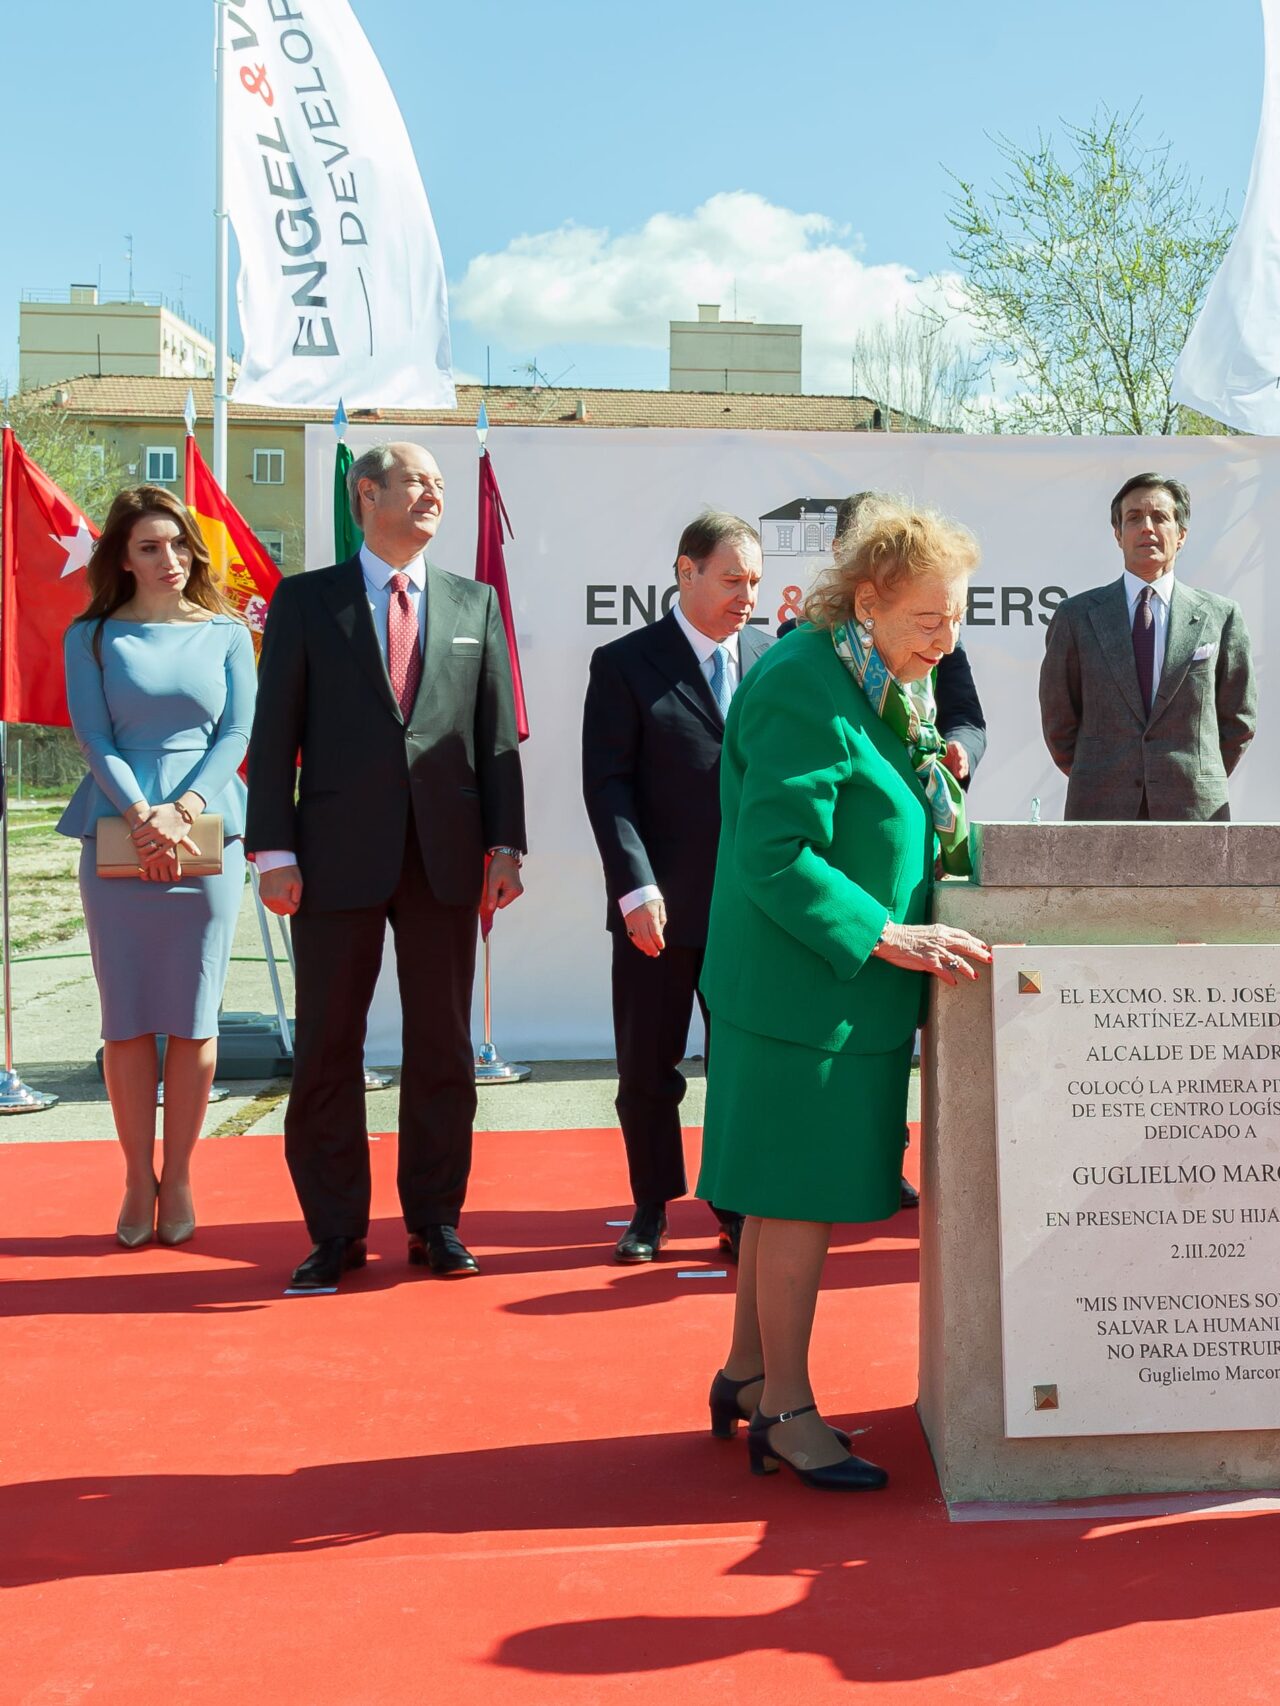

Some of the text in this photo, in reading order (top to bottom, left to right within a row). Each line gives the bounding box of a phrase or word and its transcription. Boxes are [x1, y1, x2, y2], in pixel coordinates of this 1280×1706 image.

[227, 0, 340, 356] ENGEL & V
[1059, 988, 1085, 1005] EL
[1089, 987, 1167, 1004] EXCMO.
[1172, 987, 1202, 1004] SR.
[1206, 987, 1226, 1003] D.
[1231, 983, 1277, 1003] JOSÉ
[1085, 1044, 1184, 1062] ALCALDE
[1189, 1044, 1217, 1061] DE
[1067, 1075, 1144, 1096] COLOCÓ
[1148, 1079, 1174, 1094] LA
[1177, 1079, 1258, 1094] PRIMERA
[1071, 1103, 1097, 1118] DE
[1101, 1102, 1146, 1118] ESTE
[1150, 1101, 1224, 1117] CENTRO
[1144, 1124, 1257, 1140] DEDICADO A
[1072, 1164, 1216, 1186] GUGLIELMO
[1045, 1211, 1070, 1227] EN
[1075, 1210, 1178, 1227] PRESENCIA
[1182, 1209, 1207, 1225] DE
[1211, 1208, 1235, 1224] SU
[1239, 1207, 1280, 1224] HIJA
[1170, 1242, 1246, 1259] 2.III.2022
[1075, 1296, 1118, 1312] "MIS
[1122, 1293, 1251, 1311] INVENCIONES
[1097, 1318, 1169, 1336] SALVAR
[1174, 1318, 1199, 1334] LA
[1106, 1343, 1135, 1360] NO
[1139, 1342, 1189, 1359] PARA
[1138, 1366, 1221, 1387] Guglielmo
